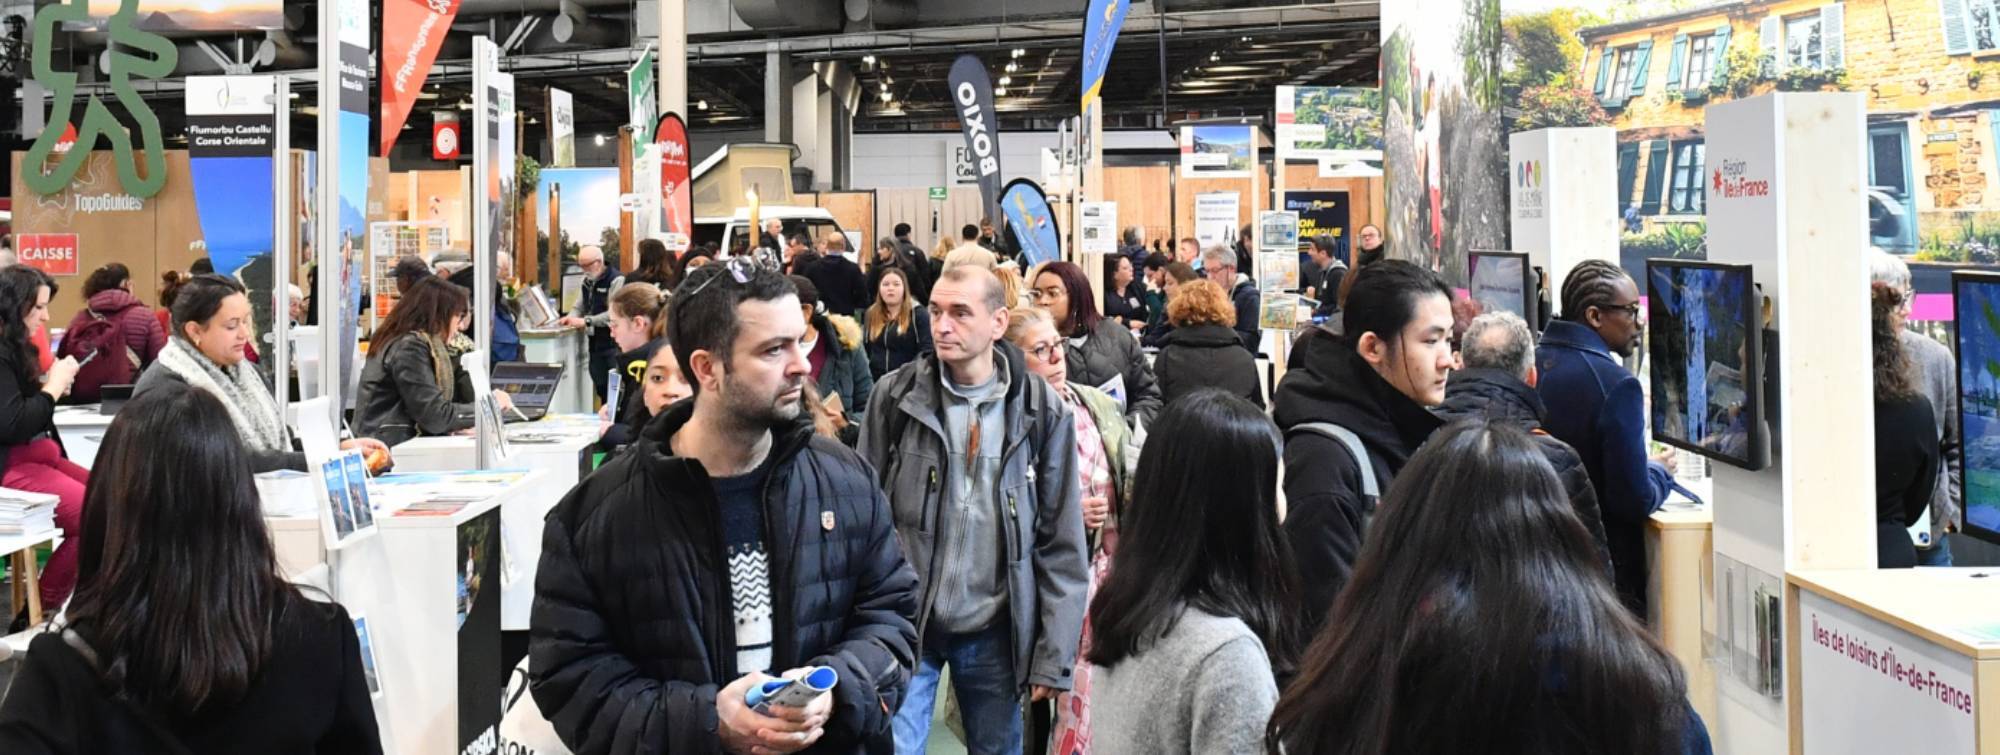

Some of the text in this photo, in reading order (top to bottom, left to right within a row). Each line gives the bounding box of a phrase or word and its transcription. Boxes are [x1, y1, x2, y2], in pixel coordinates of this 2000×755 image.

[235, 124, 272, 133] Castellu
[957, 81, 998, 177] BOXIO
[196, 136, 267, 145] Corse Orientale
[1723, 159, 1746, 180] Région
[74, 193, 143, 214] TopoGuides
[1299, 218, 1315, 228] ON
[1299, 227, 1342, 237] AMIQUE
[22, 247, 73, 260] CAISSE
[1832, 629, 1844, 654] de
[1846, 633, 1878, 670] loisirs
